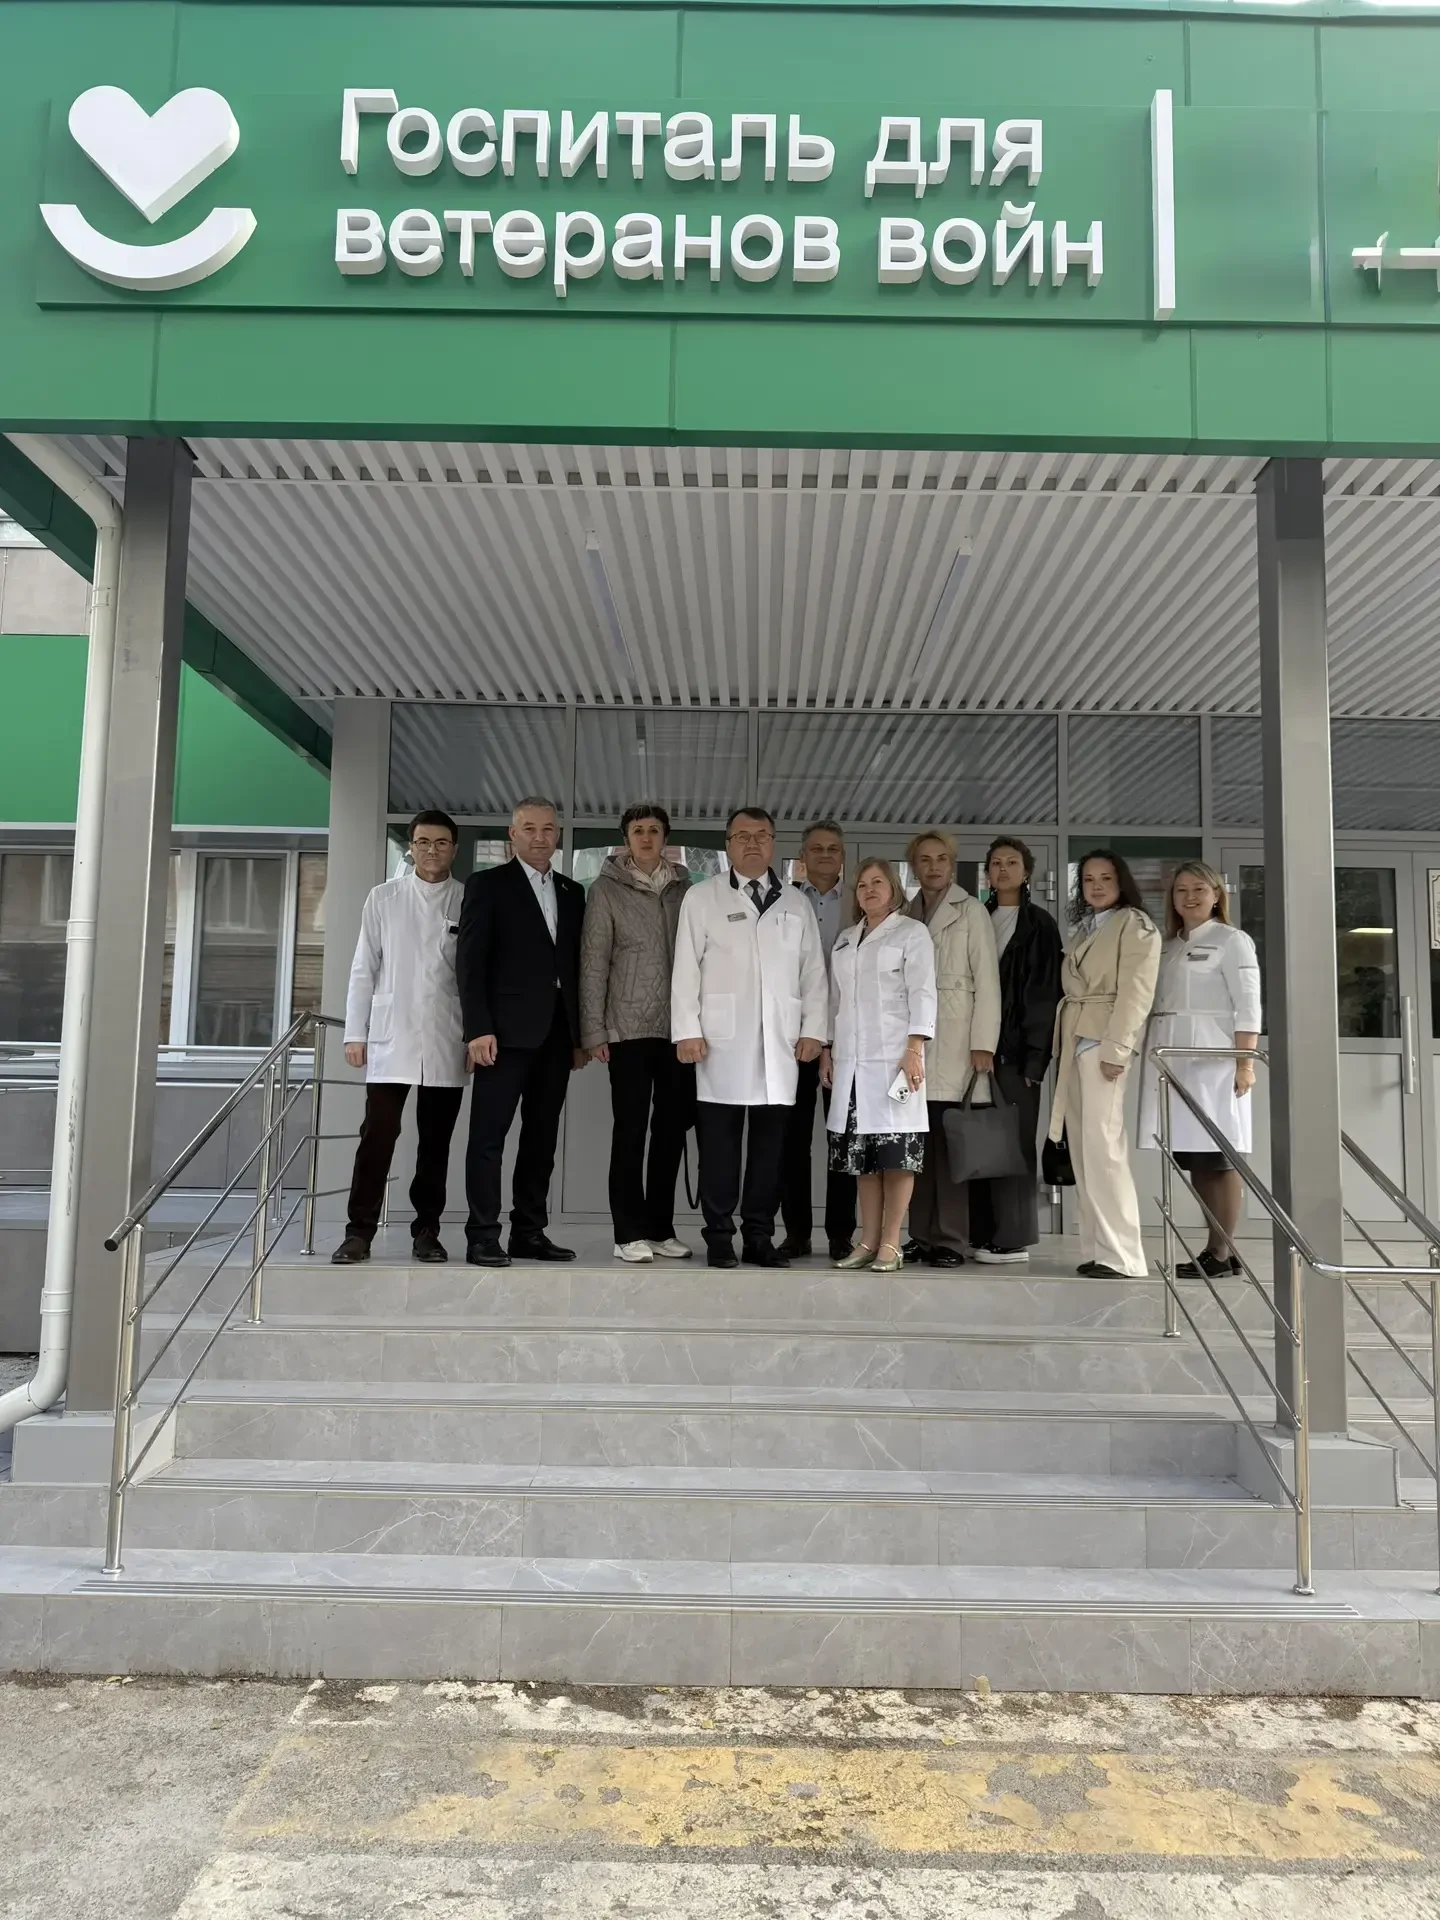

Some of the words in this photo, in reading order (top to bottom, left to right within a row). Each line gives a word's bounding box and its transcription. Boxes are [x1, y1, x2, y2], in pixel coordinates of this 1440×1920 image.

[341, 88, 835, 183] Госпиталь
[864, 116, 1042, 198] для
[335, 208, 840, 297] ветеранов
[878, 201, 1104, 288] войн
